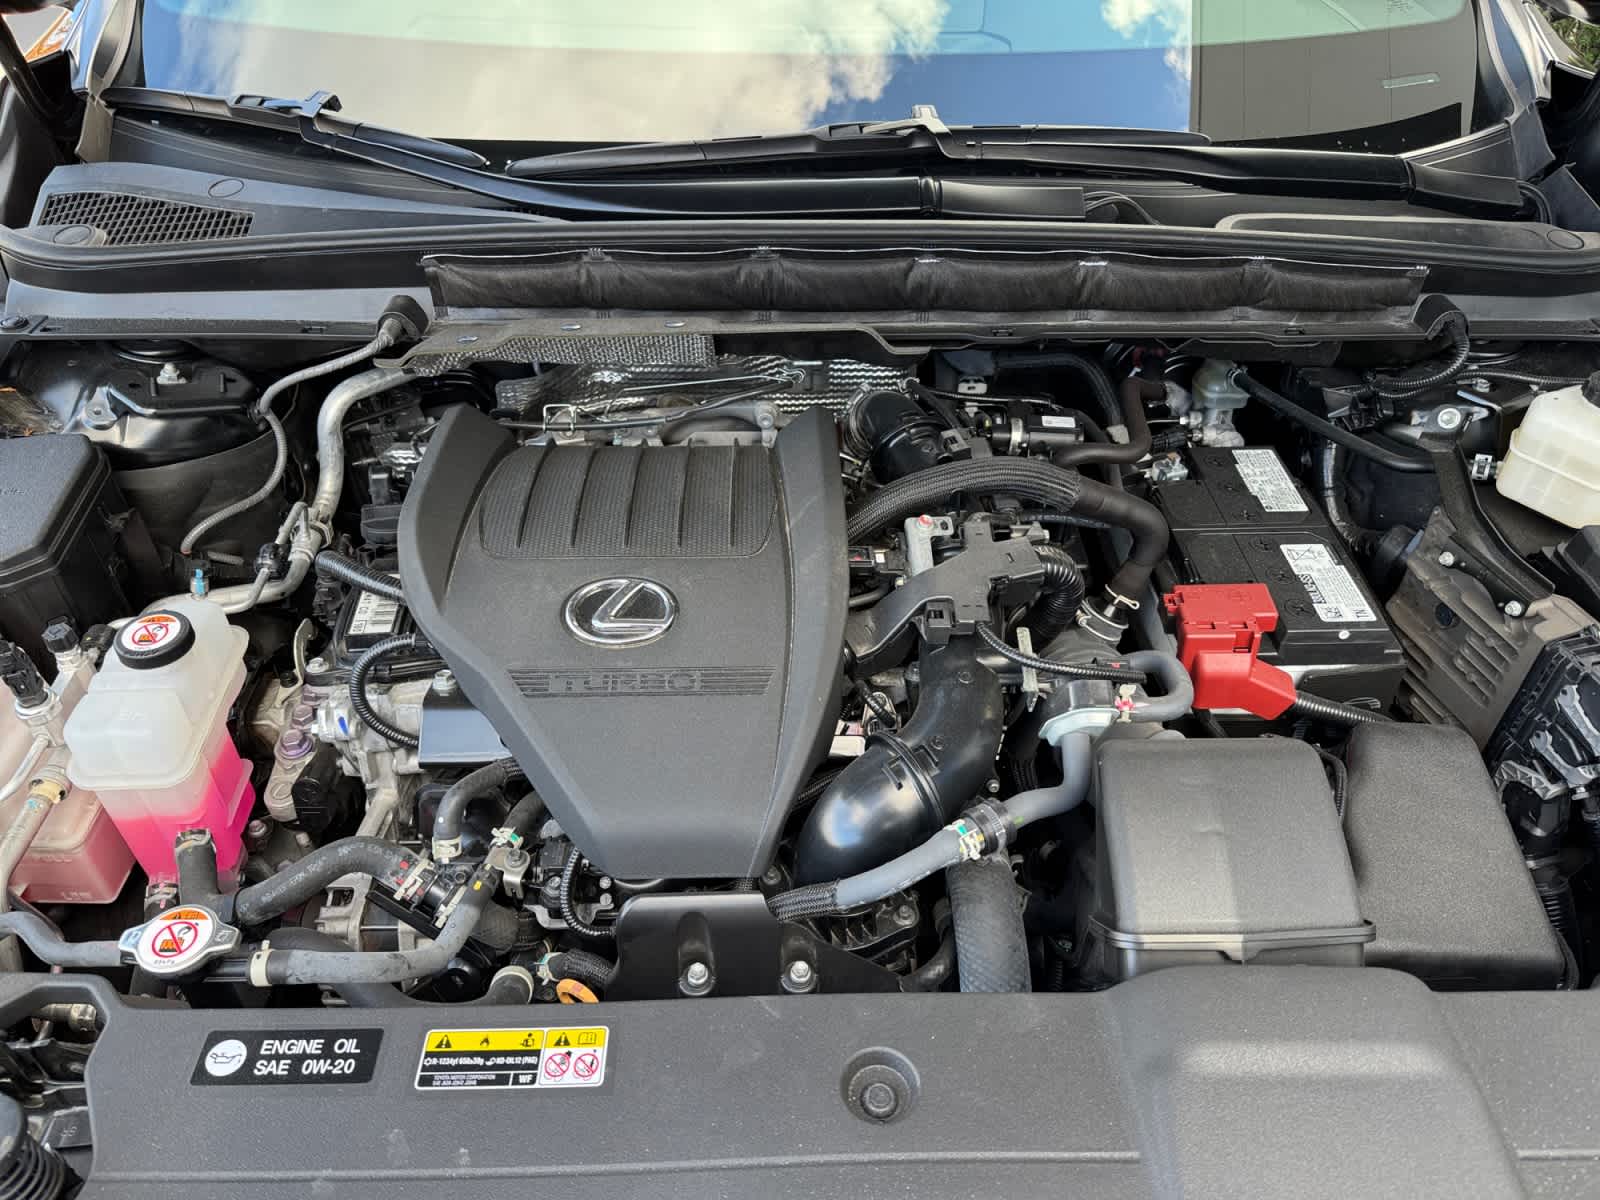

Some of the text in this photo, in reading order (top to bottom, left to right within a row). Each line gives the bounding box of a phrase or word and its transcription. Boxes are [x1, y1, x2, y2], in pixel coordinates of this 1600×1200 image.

[554, 673, 696, 691] TURBO
[260, 1038, 361, 1055] ENGINE OIL
[253, 1058, 356, 1076] SAE 0W-20
[519, 1074, 533, 1084] WF
